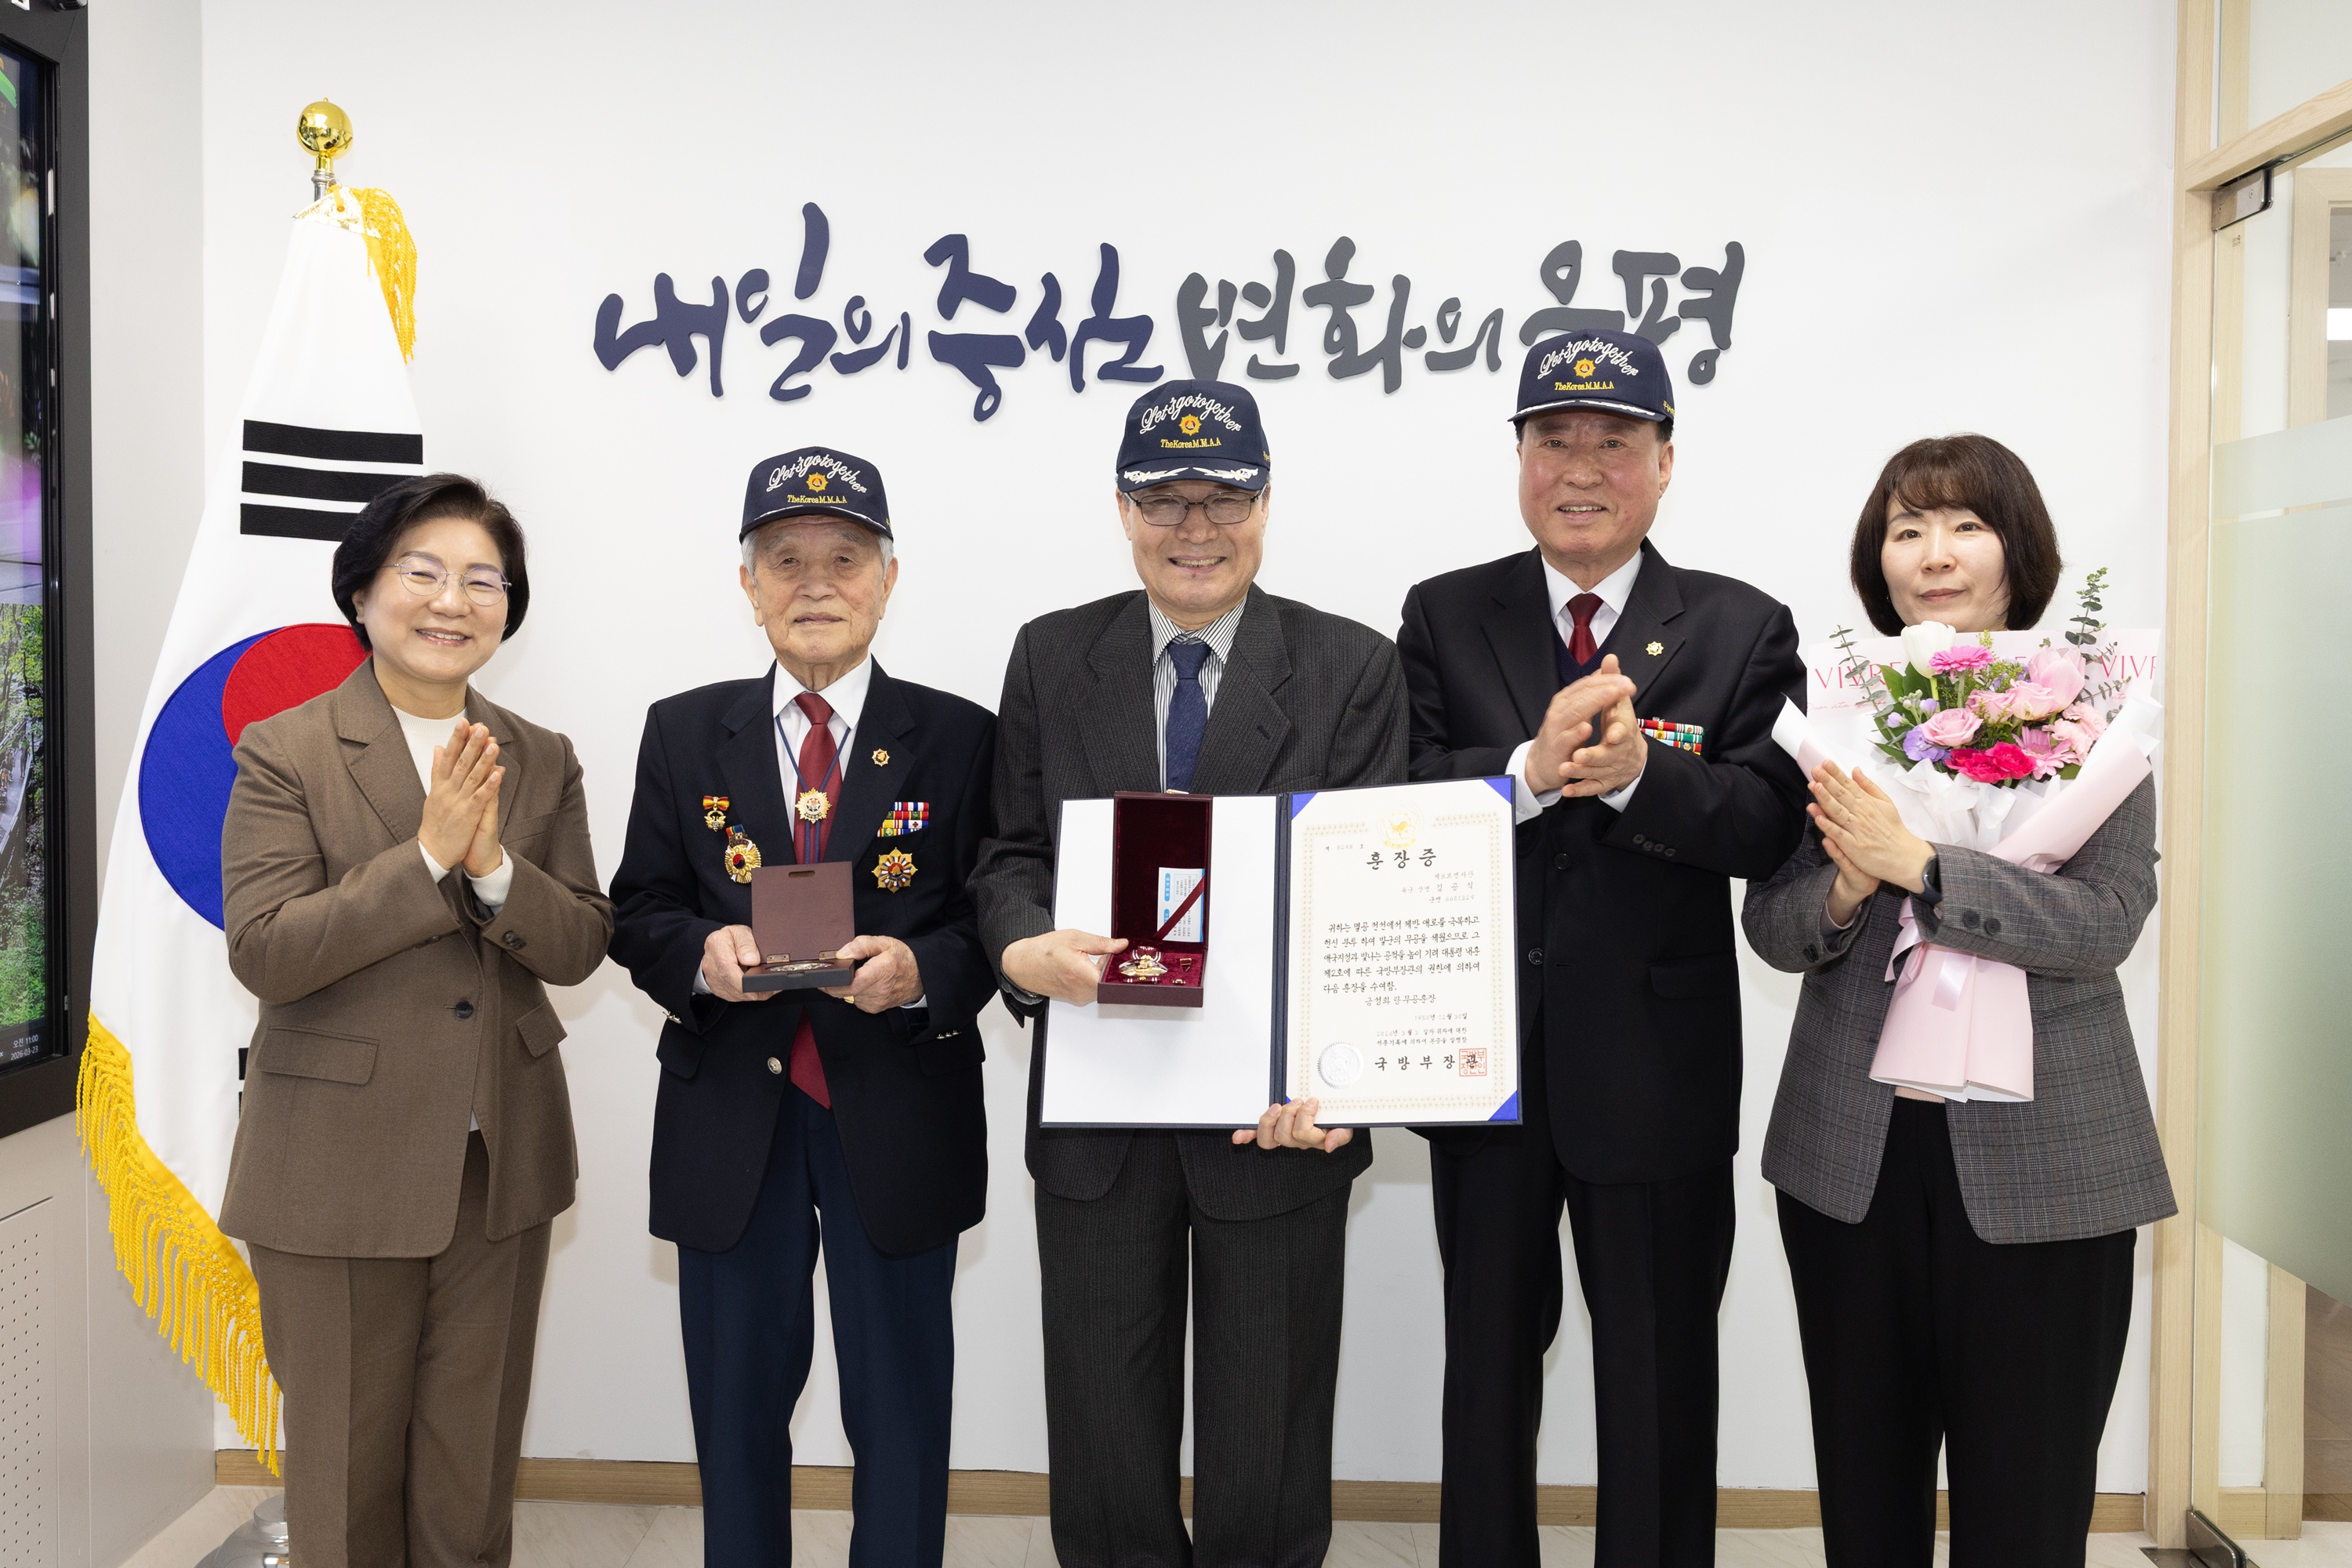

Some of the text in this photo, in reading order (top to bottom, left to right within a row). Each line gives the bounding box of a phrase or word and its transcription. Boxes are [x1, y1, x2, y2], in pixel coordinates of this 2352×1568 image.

[593, 201, 910, 401] 내일의
[924, 234, 1164, 422] 중심
[1176, 235, 1504, 394] 변화의
[1814, 661, 1901, 689] VIVR
[25, 1034, 39, 1044] 11:00
[10, 1045, 38, 1061] 2026-03-23
